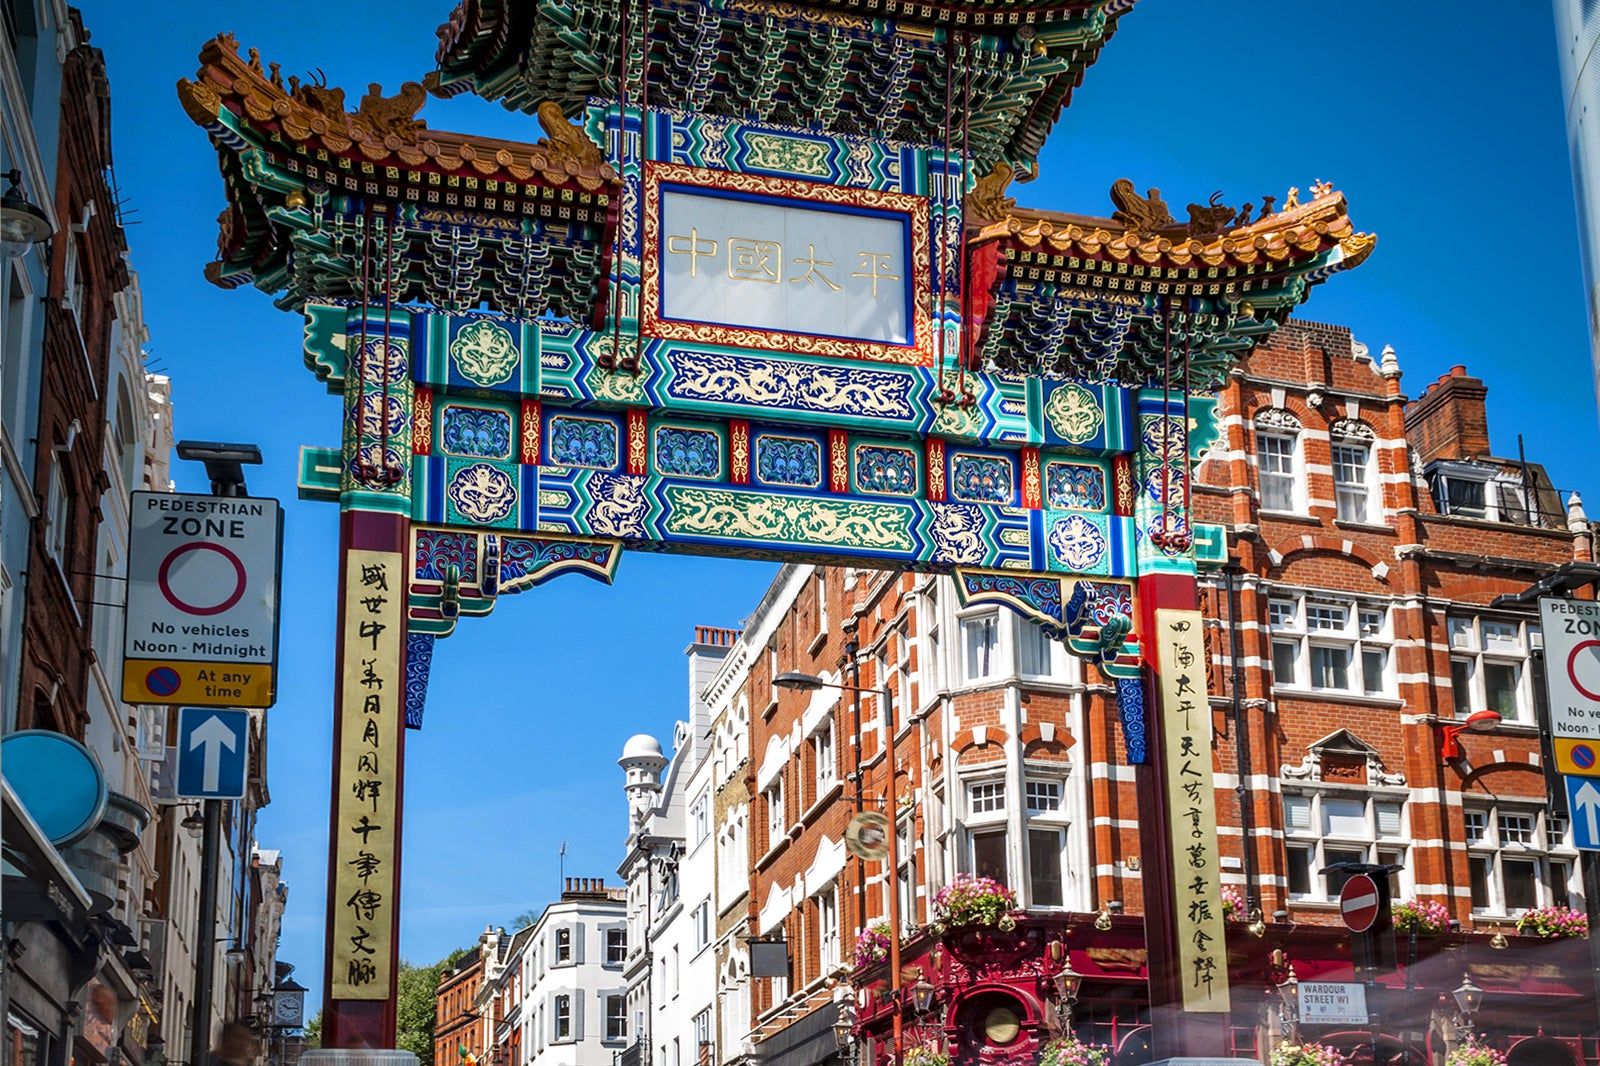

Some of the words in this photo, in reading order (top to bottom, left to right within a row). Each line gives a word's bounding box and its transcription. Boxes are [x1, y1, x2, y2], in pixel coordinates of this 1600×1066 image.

[667, 226, 901, 297] 中國太平
[147, 499, 262, 516] PEDESTRIAN
[163, 517, 244, 538] ZONE
[151, 621, 175, 635] No
[181, 624, 250, 638] vehicles
[133, 639, 178, 653] Noon
[192, 642, 267, 659] Midnight
[197, 670, 216, 682] At
[222, 672, 251, 686] any
[205, 685, 242, 698] time
[1568, 706, 1585, 718] No
[1557, 721, 1589, 733] Noon
[1304, 985, 1345, 993] WARDOUR
[1304, 995, 1334, 1003] STREET
